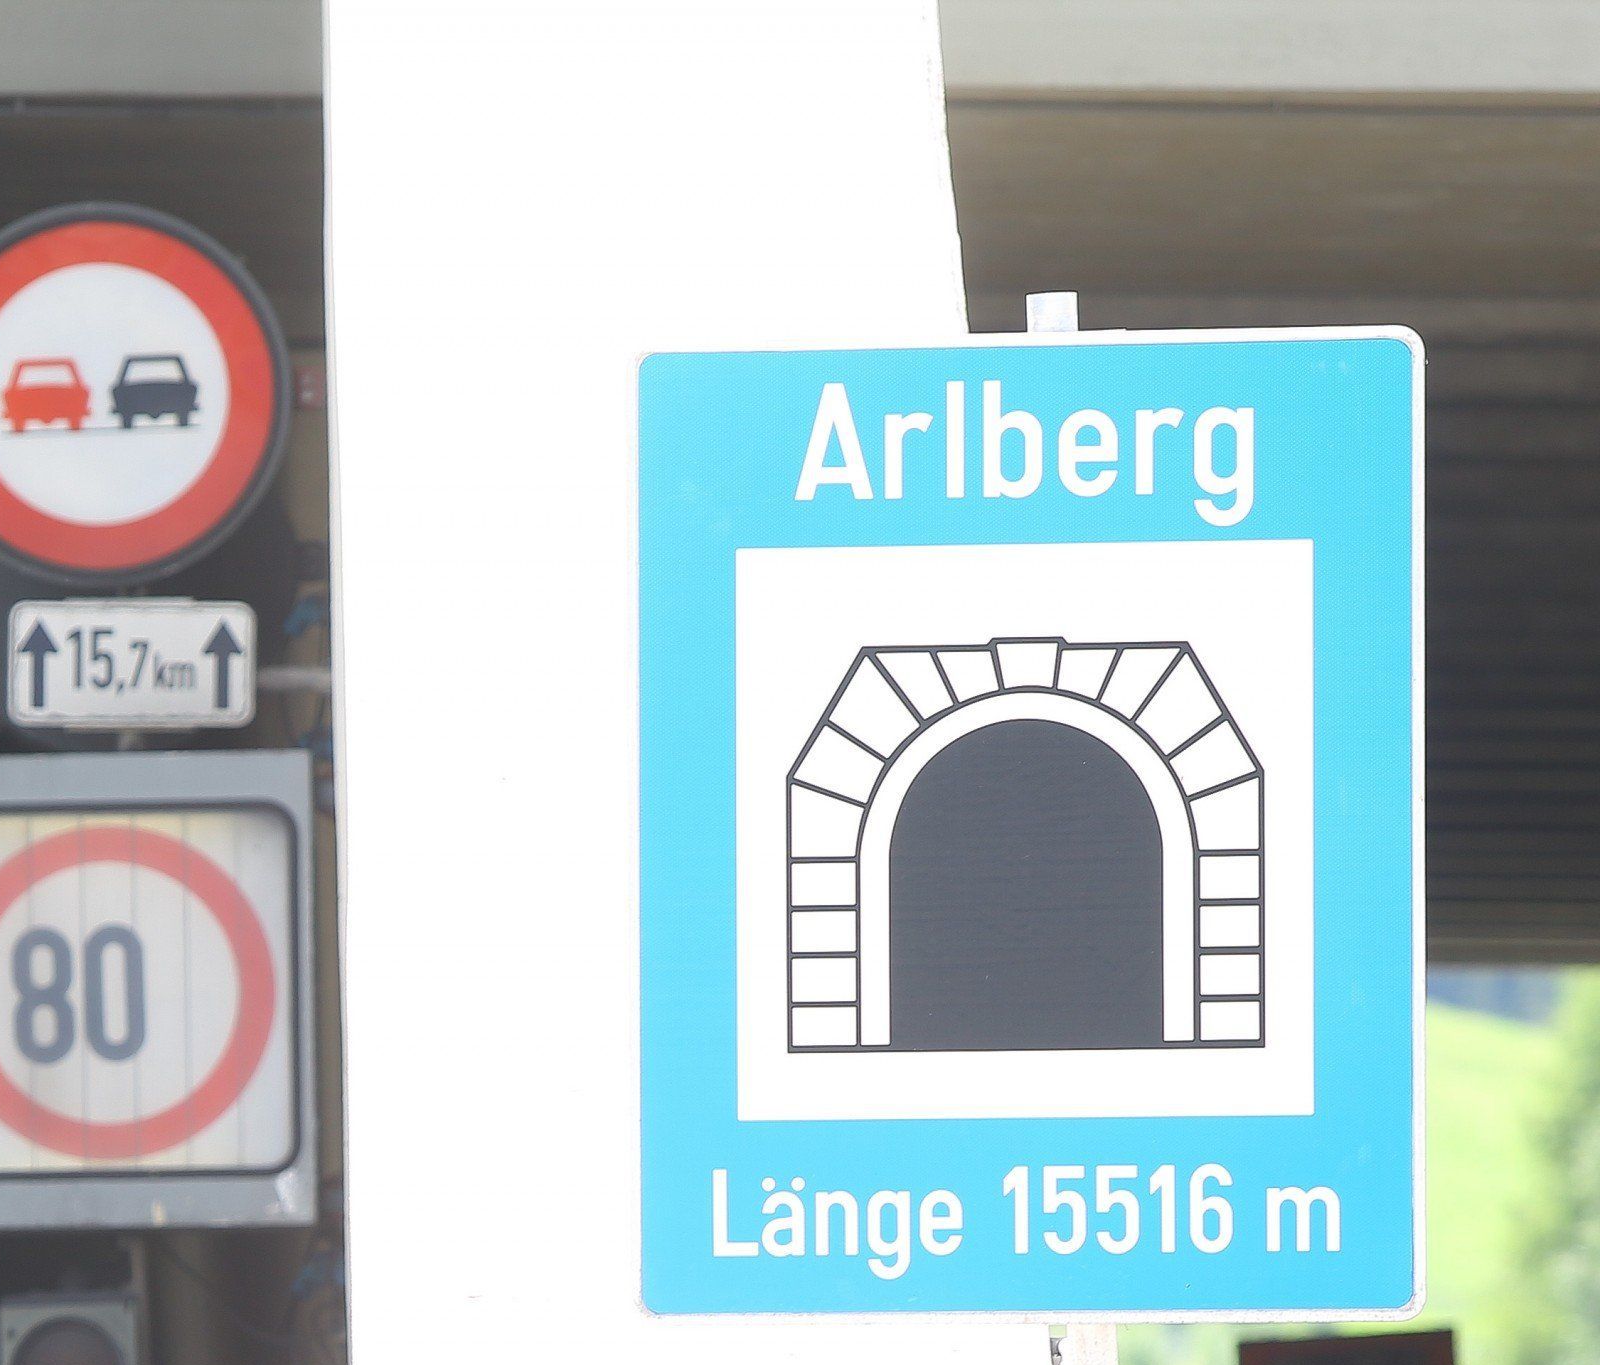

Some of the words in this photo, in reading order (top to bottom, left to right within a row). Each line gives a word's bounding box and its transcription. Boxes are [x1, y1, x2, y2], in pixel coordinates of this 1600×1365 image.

[794, 379, 1255, 527] Arlberg
[13, 925, 147, 1065] 80
[712, 1168, 964, 1281] Länge
[1002, 1163, 1234, 1256] 15516
[1266, 1186, 1341, 1252] m
